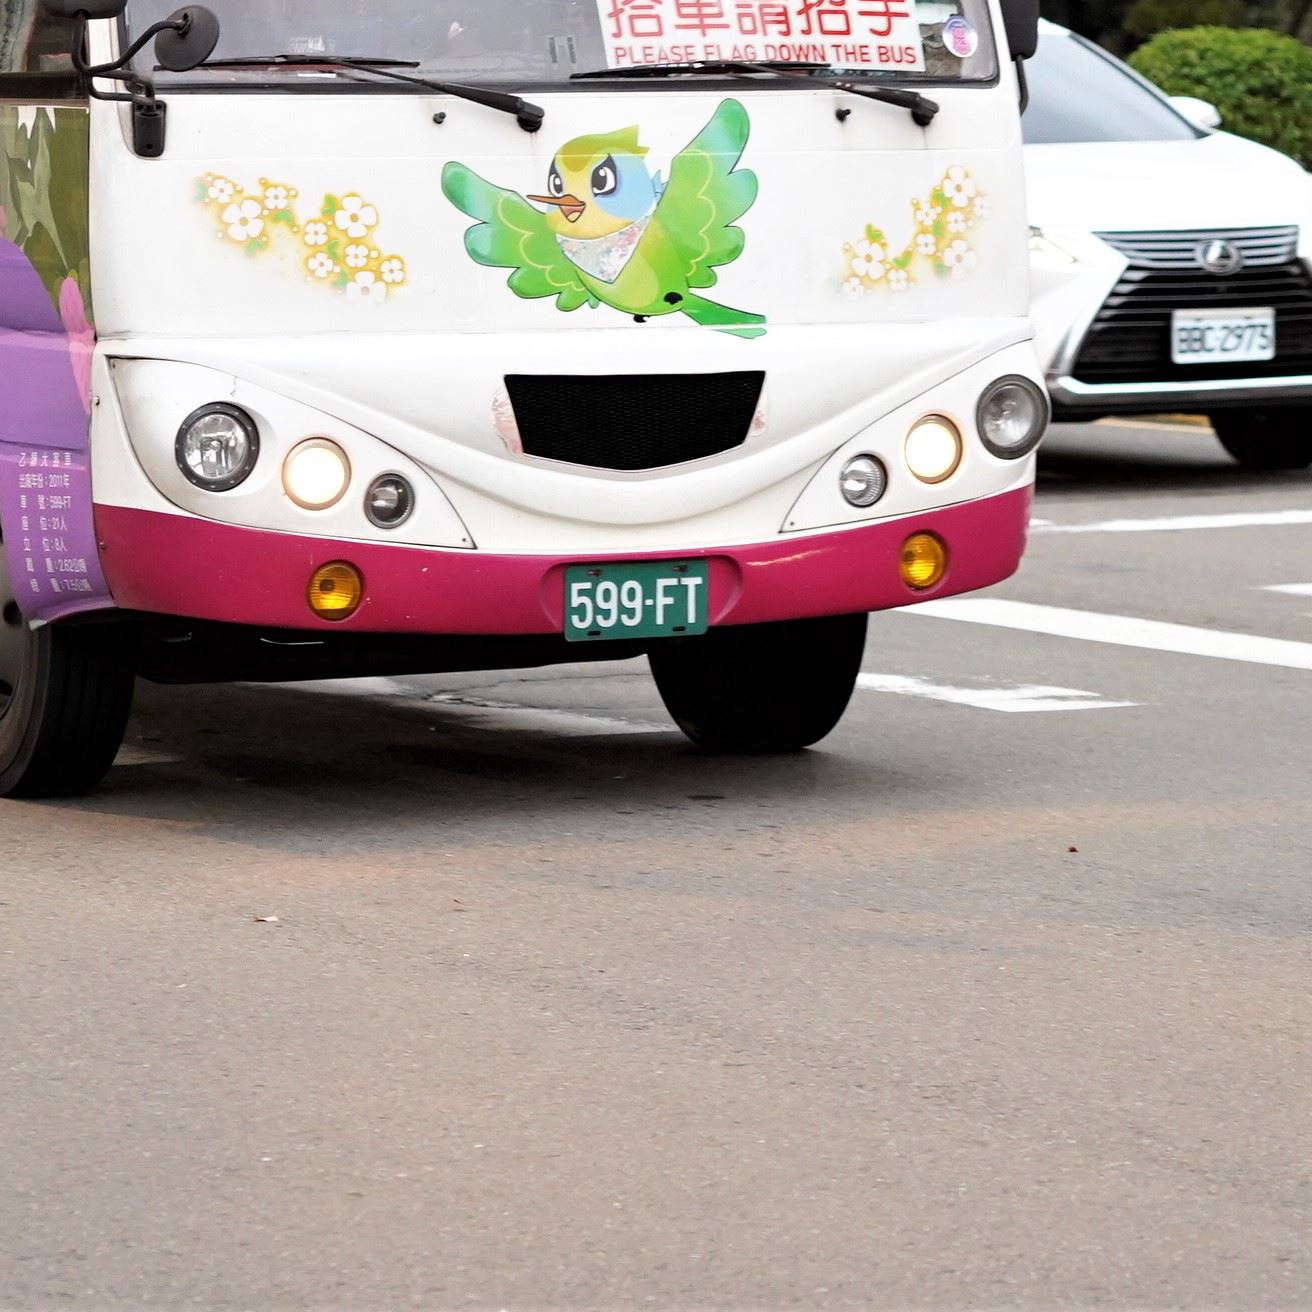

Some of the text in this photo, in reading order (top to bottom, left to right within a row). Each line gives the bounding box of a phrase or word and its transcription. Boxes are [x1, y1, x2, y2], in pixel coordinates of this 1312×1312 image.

[614, 43, 918, 65] PLEASE FLAG DOWN THE BUS
[570, 577, 703, 629] 599-FT
